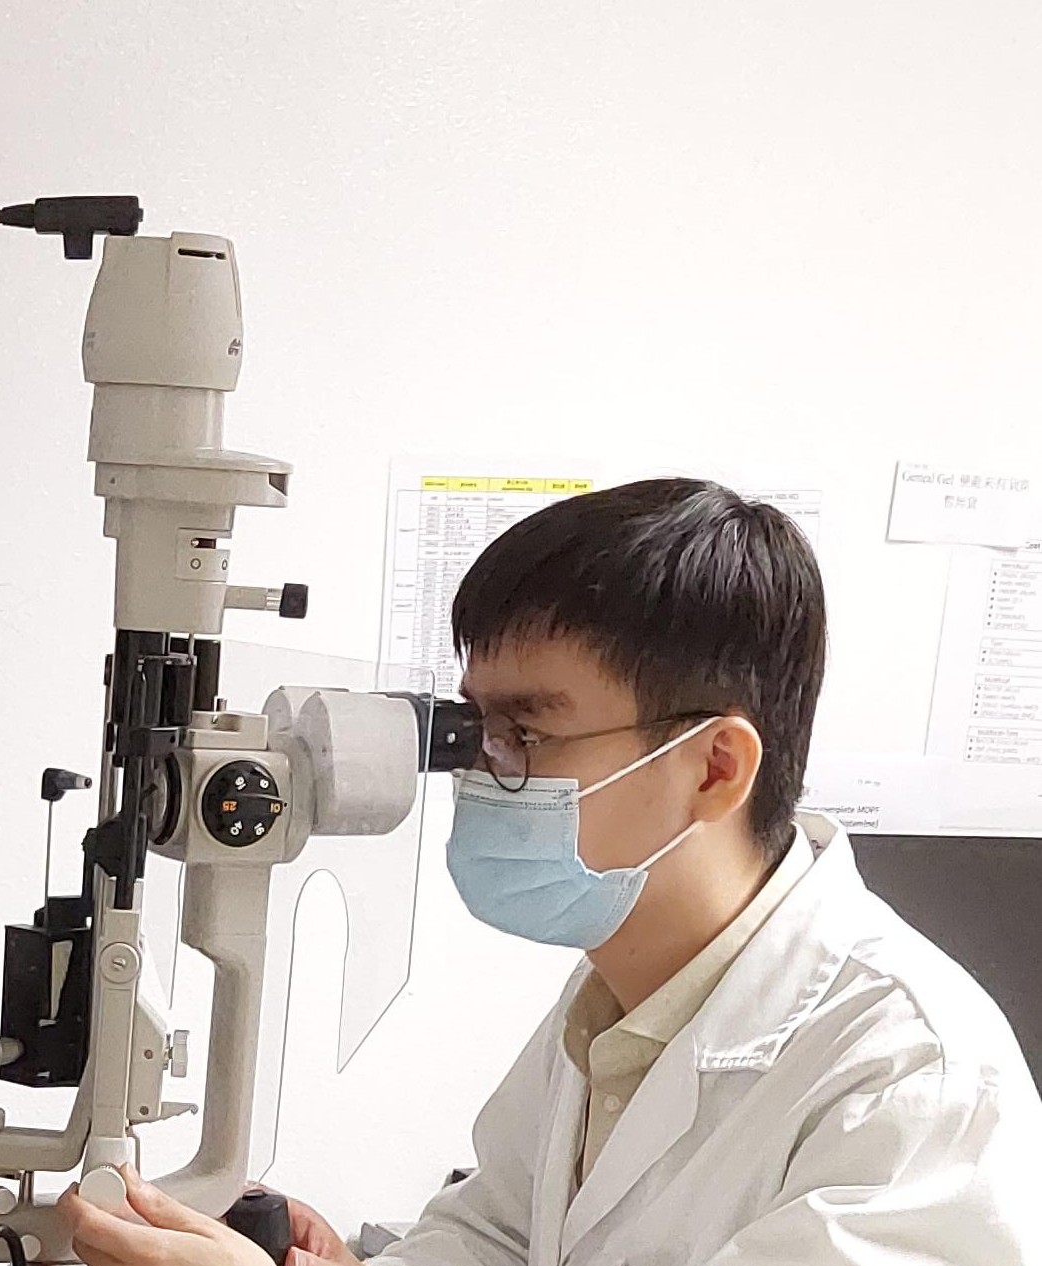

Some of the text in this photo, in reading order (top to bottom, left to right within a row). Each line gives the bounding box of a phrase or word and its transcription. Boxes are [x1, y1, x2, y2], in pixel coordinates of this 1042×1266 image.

[222, 801, 238, 812] 25
[270, 803, 281, 813] 10
[230, 820, 243, 836] 40
[254, 822, 265, 836] 16
